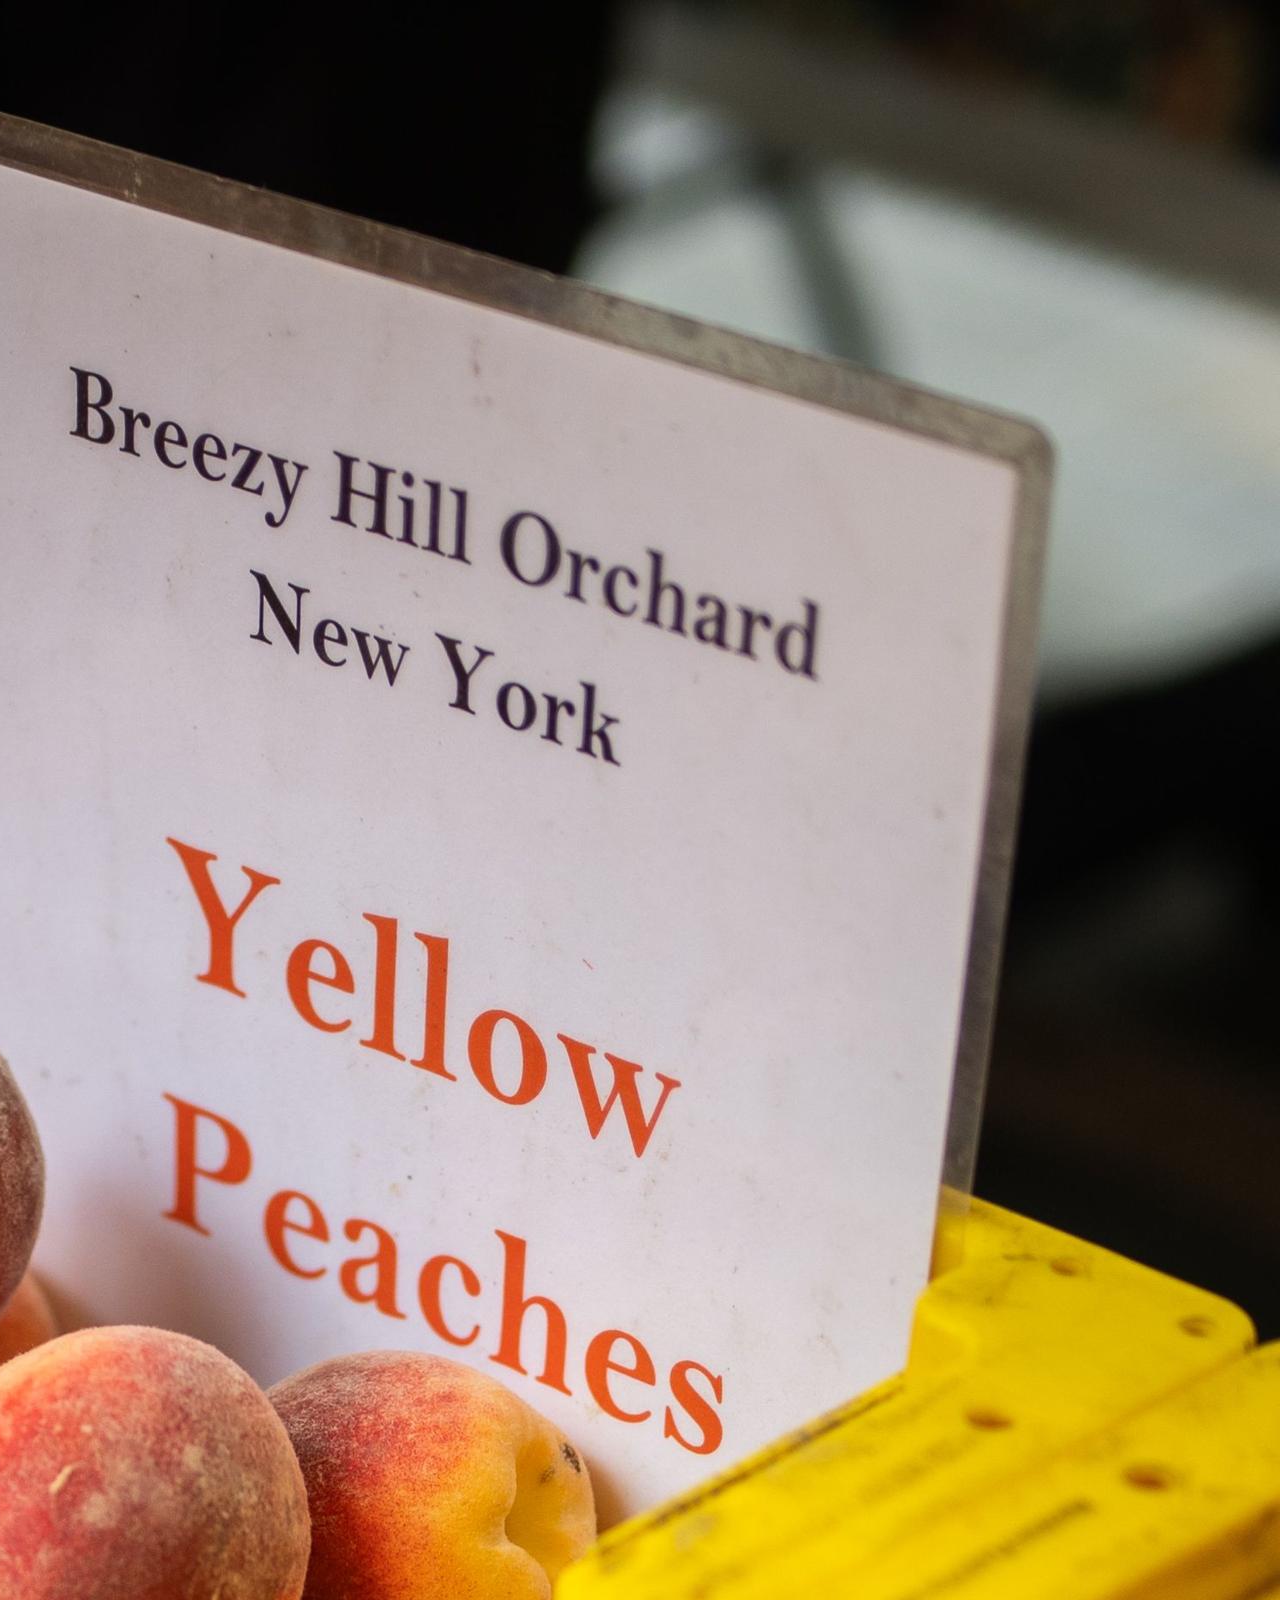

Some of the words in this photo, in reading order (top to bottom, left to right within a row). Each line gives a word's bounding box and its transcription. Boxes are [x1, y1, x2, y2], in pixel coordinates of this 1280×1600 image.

[68, 364, 310, 528] Breezy
[329, 449, 473, 567] Hill
[498, 510, 821, 681] Orchard
[249, 568, 412, 688] New
[433, 631, 622, 768] York
[165, 836, 682, 1160] Yellow
[160, 1092, 726, 1457] Peaches
